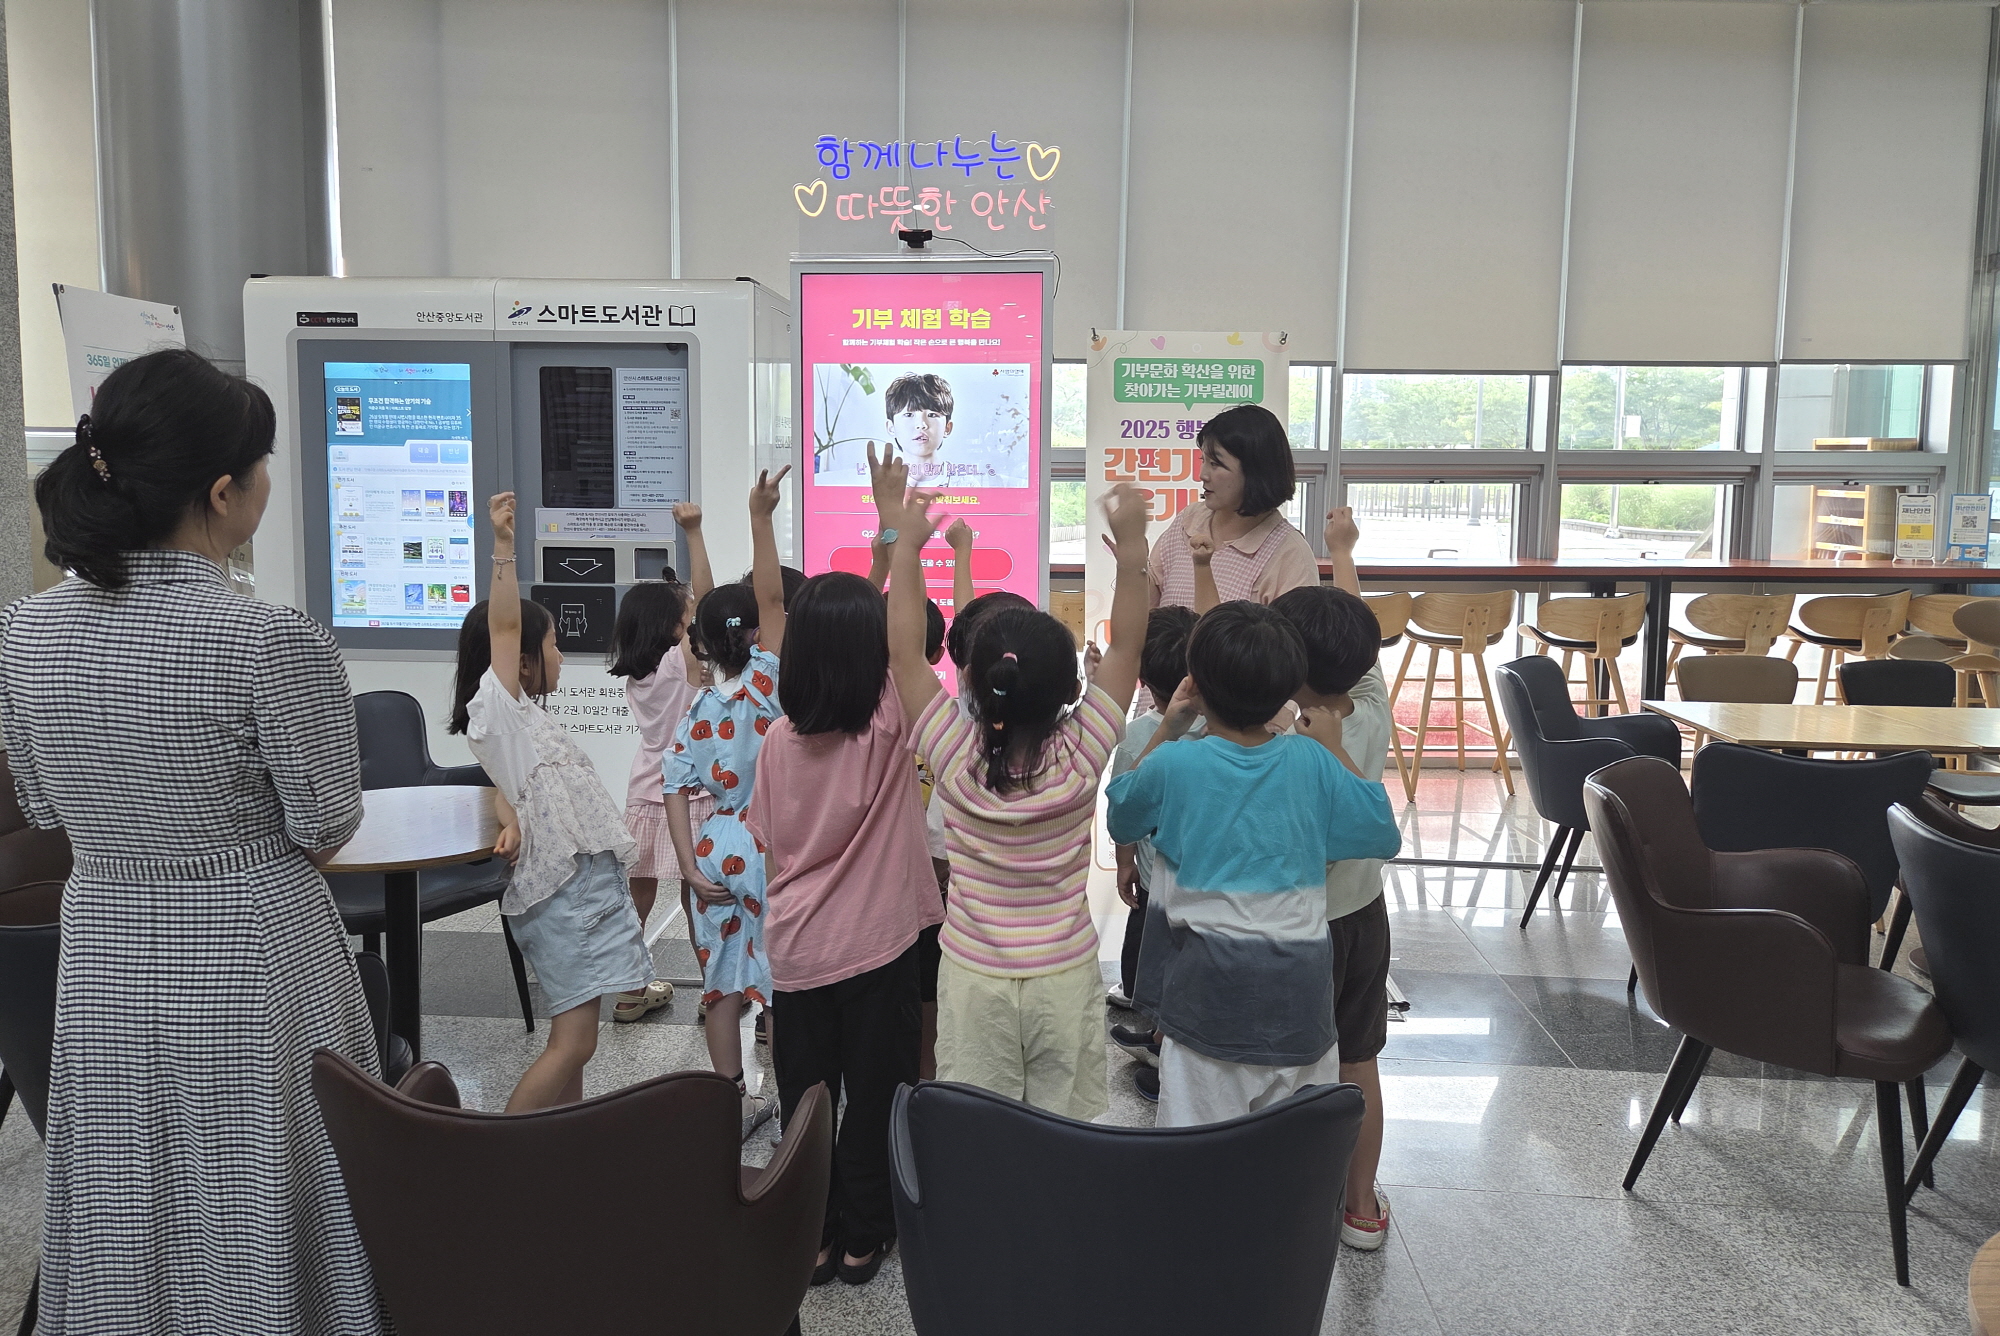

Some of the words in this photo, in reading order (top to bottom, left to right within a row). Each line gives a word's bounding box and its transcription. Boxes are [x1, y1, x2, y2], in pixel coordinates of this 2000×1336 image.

[835, 186, 957, 234] 따뜻한
[970, 188, 1052, 231] 안산
[416, 311, 484, 323] 안산중앙도서관
[537, 304, 662, 327] 스마트도서관
[852, 308, 893, 329] 기부
[900, 308, 942, 329] 체험
[949, 308, 992, 329] 학습
[86, 354, 110, 368] 365일
[1121, 363, 1178, 379] 기부문화
[1181, 363, 1224, 379] 확산을
[1227, 364, 1256, 380] 위한
[1124, 382, 1181, 398] 찾아가는
[1184, 383, 1252, 399] 기부릴레이
[1120, 419, 1170, 439] 2025
[856, 462, 867, 475] 난
[936, 559, 944, 567] 수
[570, 688, 596, 697] 도서관
[599, 688, 626, 698] 회원증
[583, 706, 608, 716] 10일간
[612, 706, 630, 716] 대출
[570, 724, 622, 734] 스마트도서관
